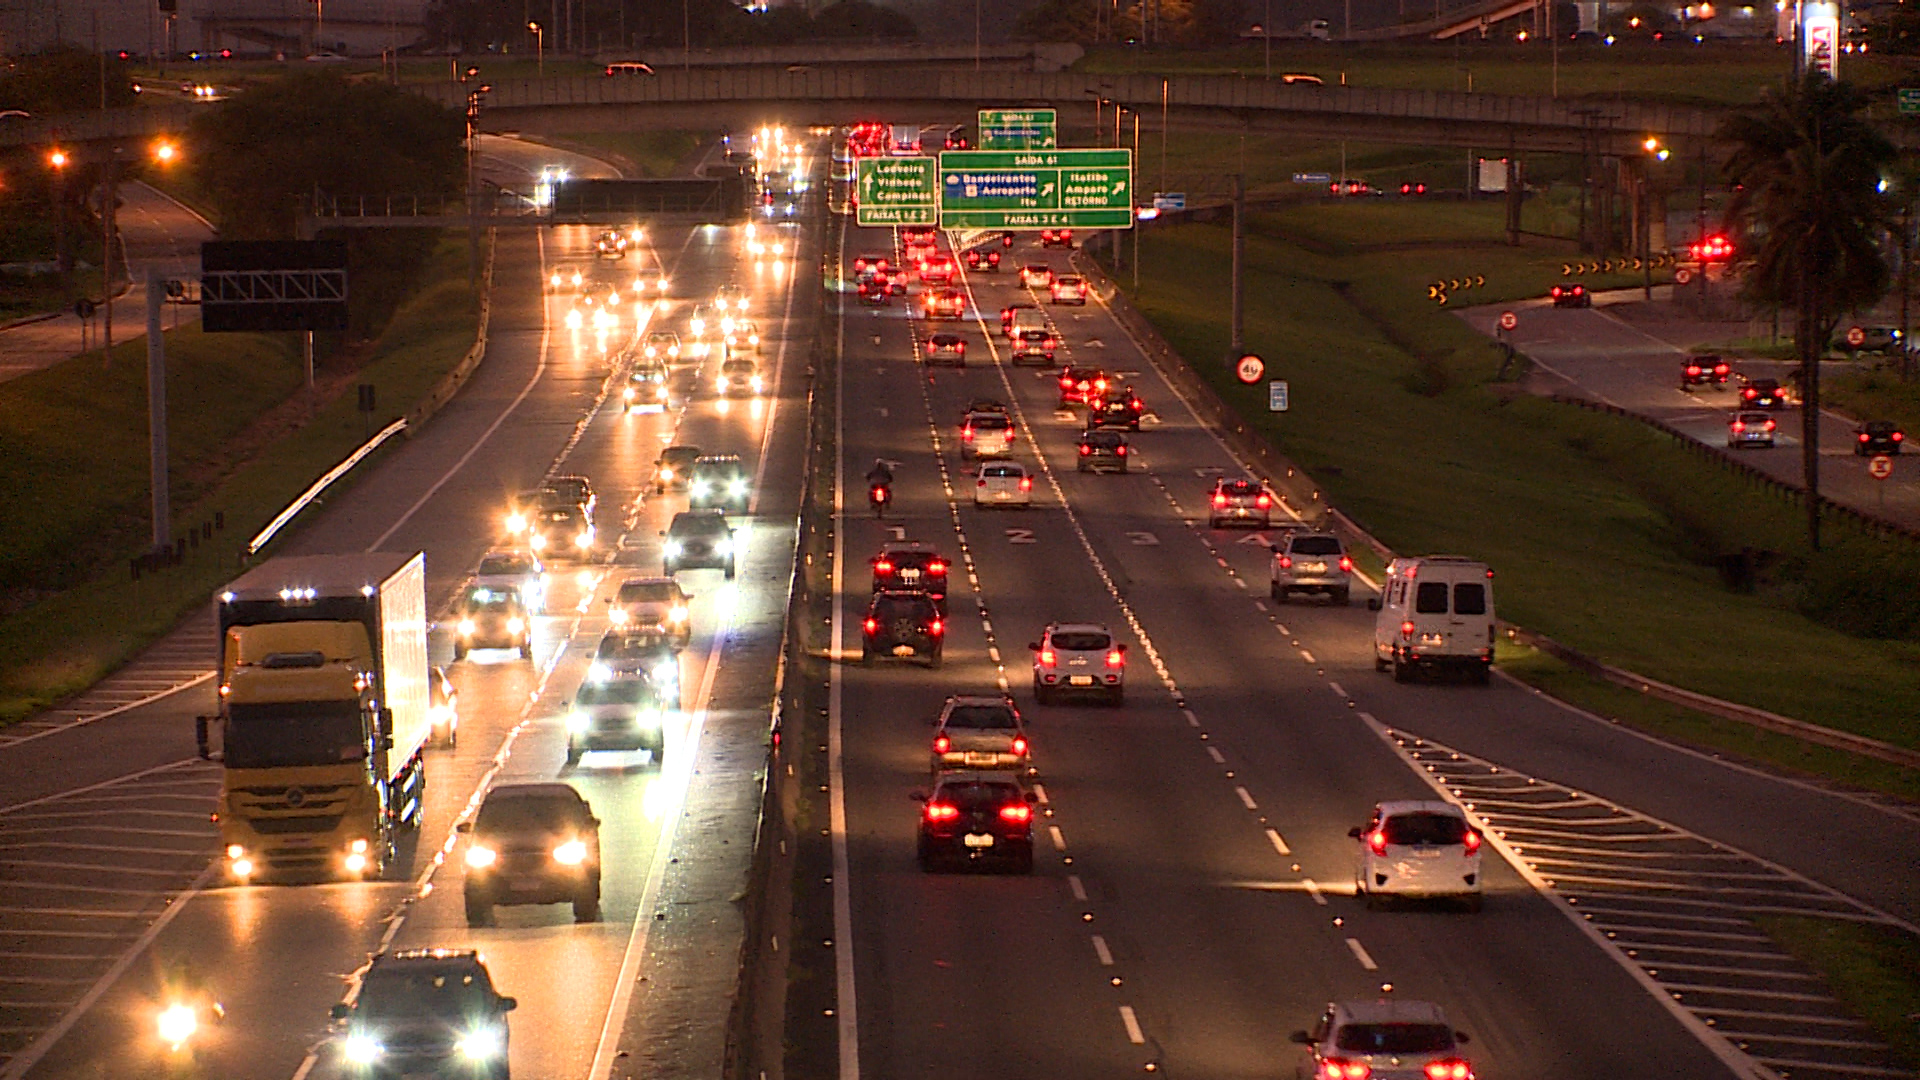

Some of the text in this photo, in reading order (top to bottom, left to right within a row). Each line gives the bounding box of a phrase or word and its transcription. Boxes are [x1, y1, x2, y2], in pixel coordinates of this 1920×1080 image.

[1014, 153, 1058, 165] SAÍDA 61
[878, 178, 923, 187] Vinhedo
[963, 174, 1037, 184] Bandeirantes
[982, 186, 1037, 197] Aeroporto
[1065, 185, 1109, 195] Amparo
[877, 191, 932, 202] Campinas
[1065, 196, 1109, 206] RETORNO
[1004, 214, 1039, 225] FAIXAS
